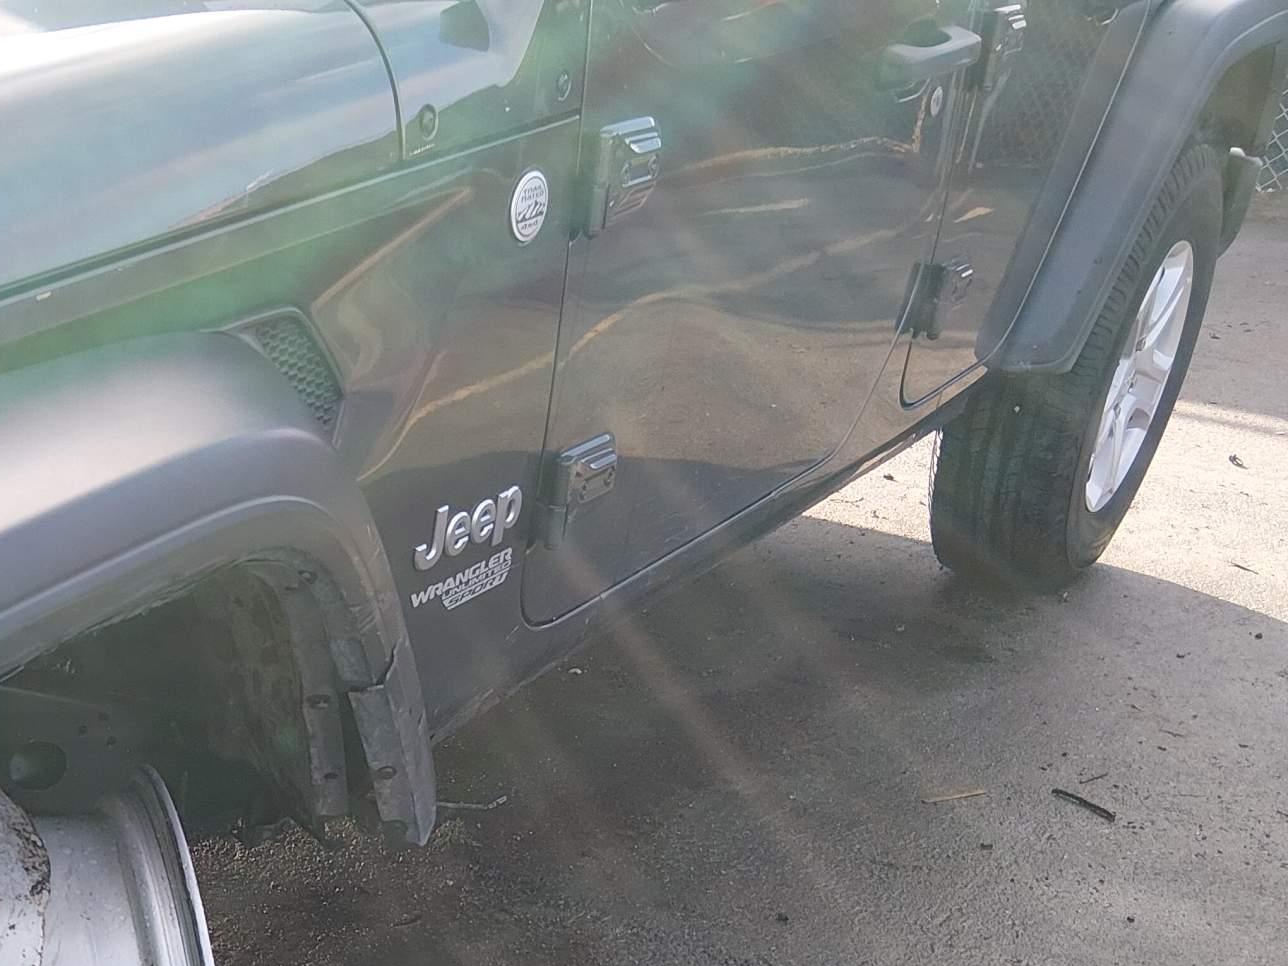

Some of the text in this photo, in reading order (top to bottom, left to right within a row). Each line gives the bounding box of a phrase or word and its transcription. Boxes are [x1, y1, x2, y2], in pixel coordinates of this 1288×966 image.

[414, 485, 523, 572] Jeep
[410, 547, 513, 608] WRANGLER
[441, 561, 512, 601] UNLIMITED
